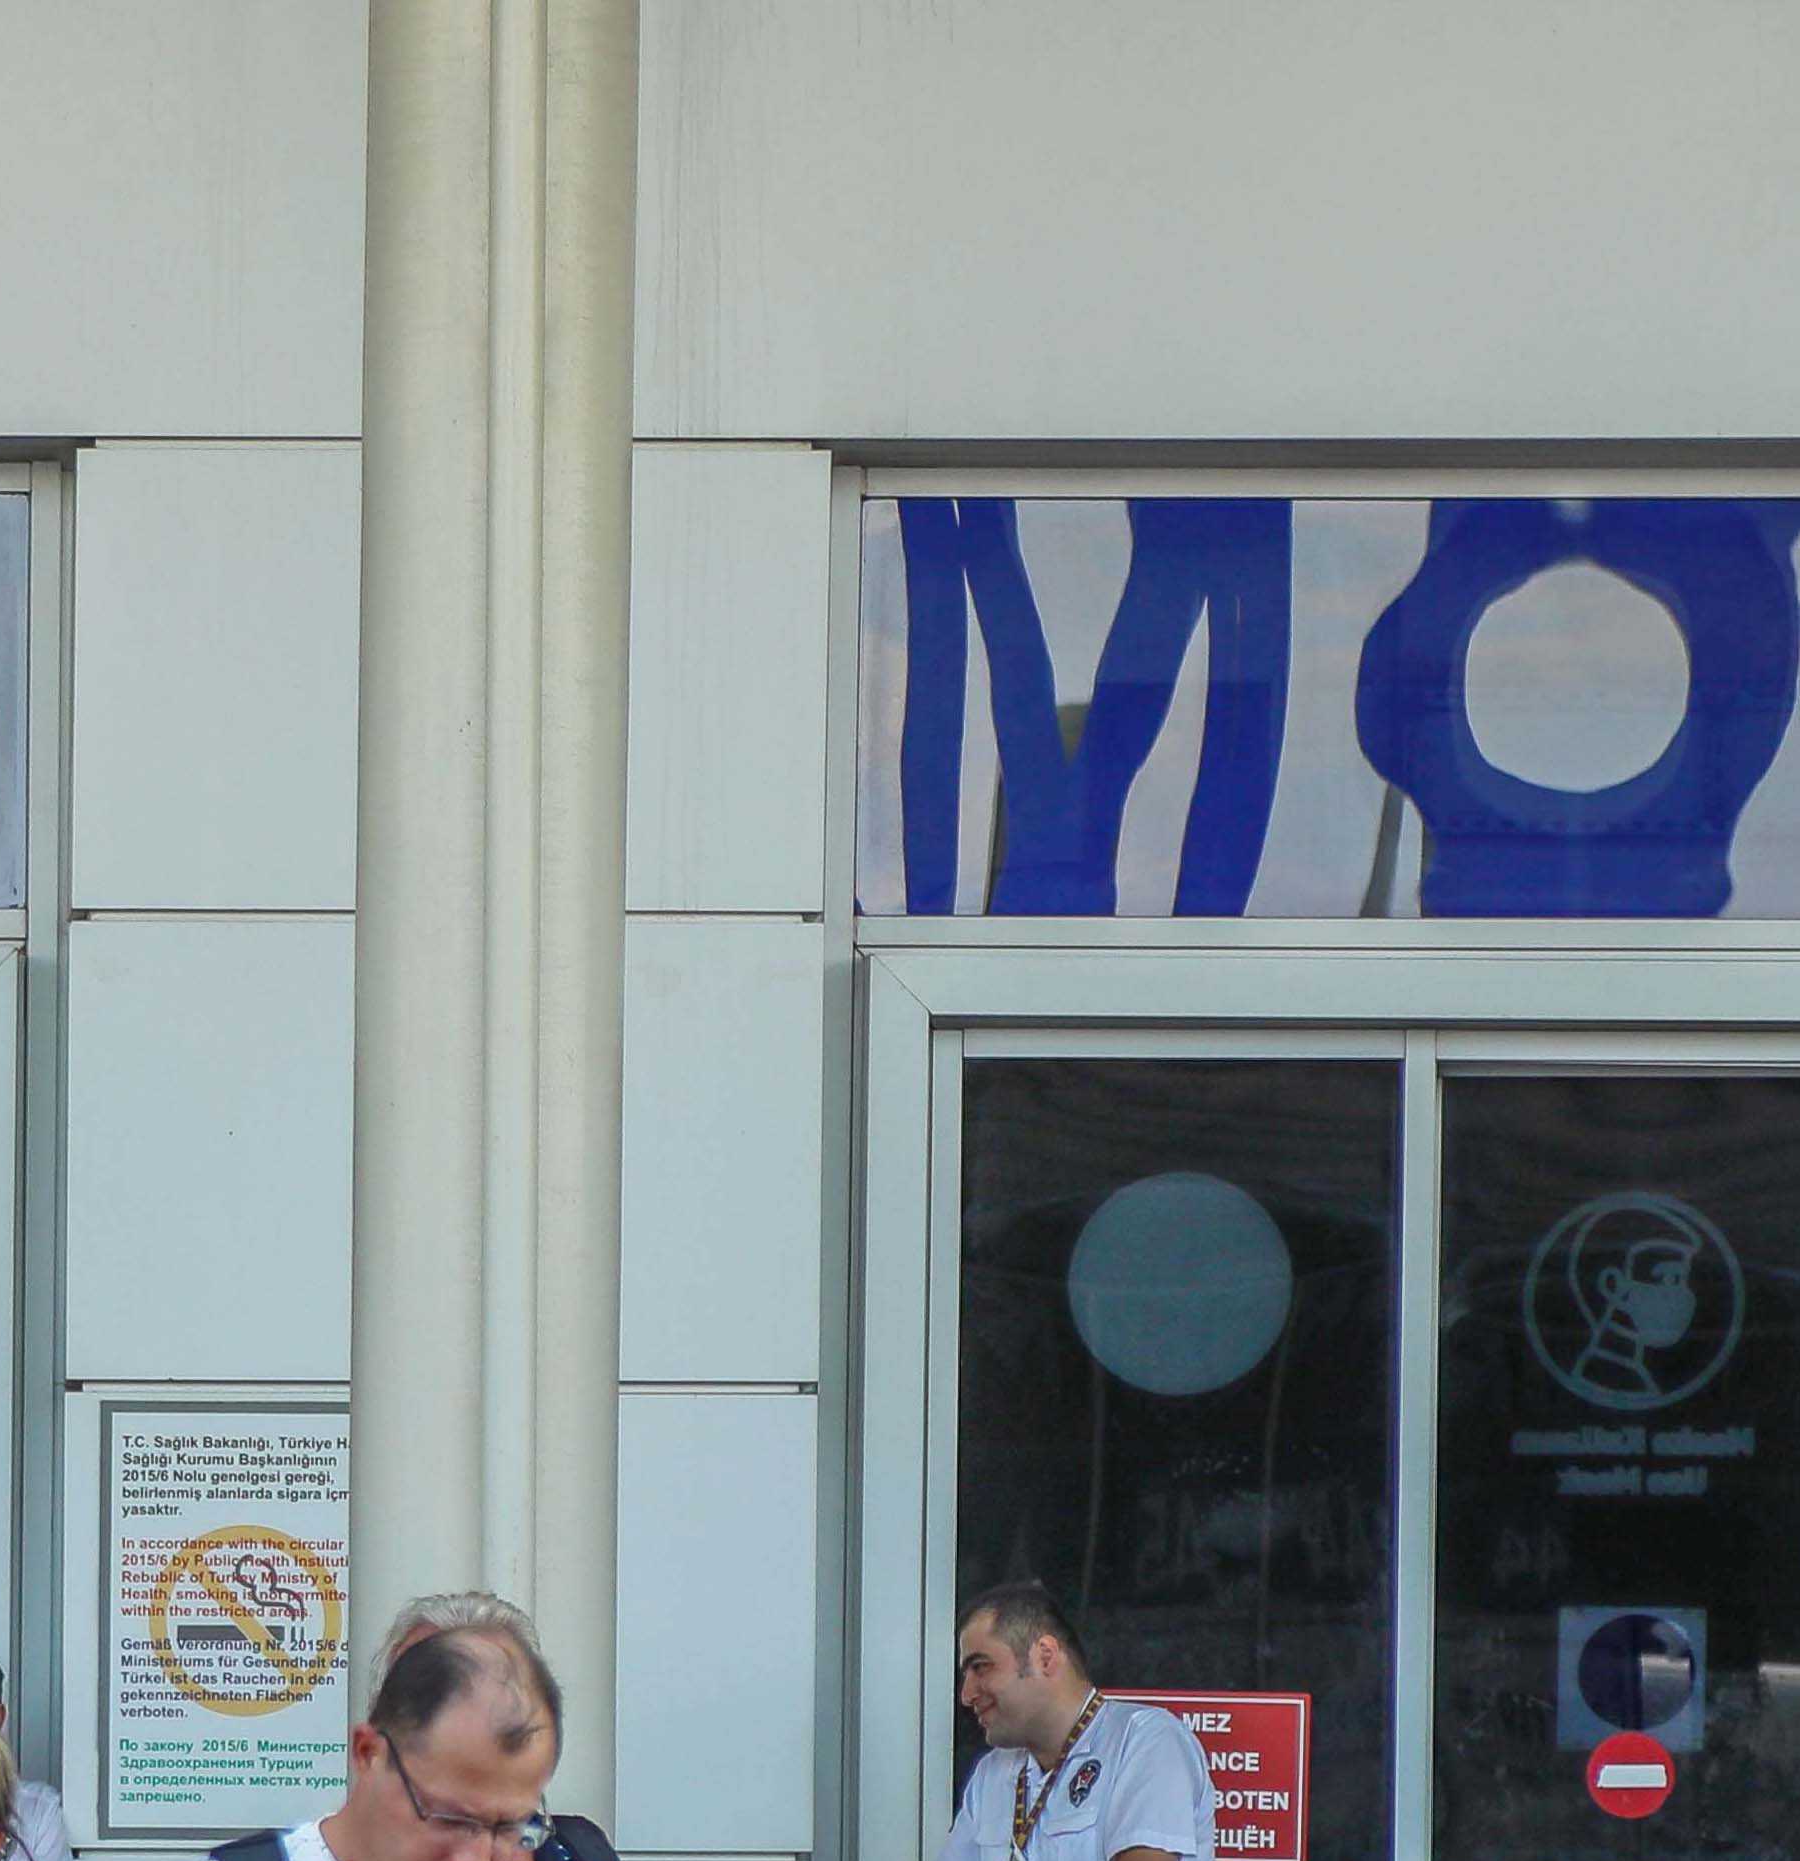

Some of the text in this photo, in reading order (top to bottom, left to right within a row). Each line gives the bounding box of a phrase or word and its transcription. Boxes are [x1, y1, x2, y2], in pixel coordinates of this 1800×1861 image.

[122, 1436, 149, 1448] T.C.
[154, 1435, 198, 1451] Sağlık
[202, 1436, 274, 1451] Bakanlığı,
[279, 1436, 332, 1452] Türkiye
[122, 1452, 337, 1468] Sağlığı Kurumu Başkanlığının
[122, 1470, 335, 1485] 2015/6 Nolu genelgesi gereği,
[122, 1486, 350, 1502] belirlenmiş alanlarda sigara içm
[122, 1503, 183, 1518] yasaktır.
[121, 1537, 344, 1550] In accordance with the circular
[121, 1554, 349, 1569] 2015/6 by Public Health Instituti
[189, 1571, 205, 1584] of
[208, 1571, 256, 1586] Turkey
[261, 1572, 318, 1586] Ministry
[323, 1572, 338, 1584] of
[176, 1588, 238, 1603] smoking
[243, 1589, 253, 1600] is
[259, 1590, 281, 1600] not
[288, 1589, 347, 1603] permitte
[121, 1605, 164, 1617] within
[169, 1605, 191, 1617] the
[196, 1605, 265, 1617] restricted
[121, 1638, 171, 1651] Gemäß
[177, 1639, 261, 1653] Verordnung
[265, 1639, 285, 1651] Nr.
[290, 1639, 336, 1651] 2015/6
[121, 1655, 348, 1669] Ministeriums für Gesundheit de
[121, 1672, 335, 1685] Türkei ist das Rauchen in den
[120, 1689, 312, 1704] gekennzeichneten Flächen
[120, 1706, 188, 1718] verboten.
[119, 1739, 347, 1755] По закону 2015/6 Министерст
[120, 1756, 313, 1772] Здравоохранения Турции
[120, 1776, 347, 1789] в определенных местах курен
[120, 1792, 205, 1805] запрещено.
[1214, 1791, 1289, 1811] BOTEN
